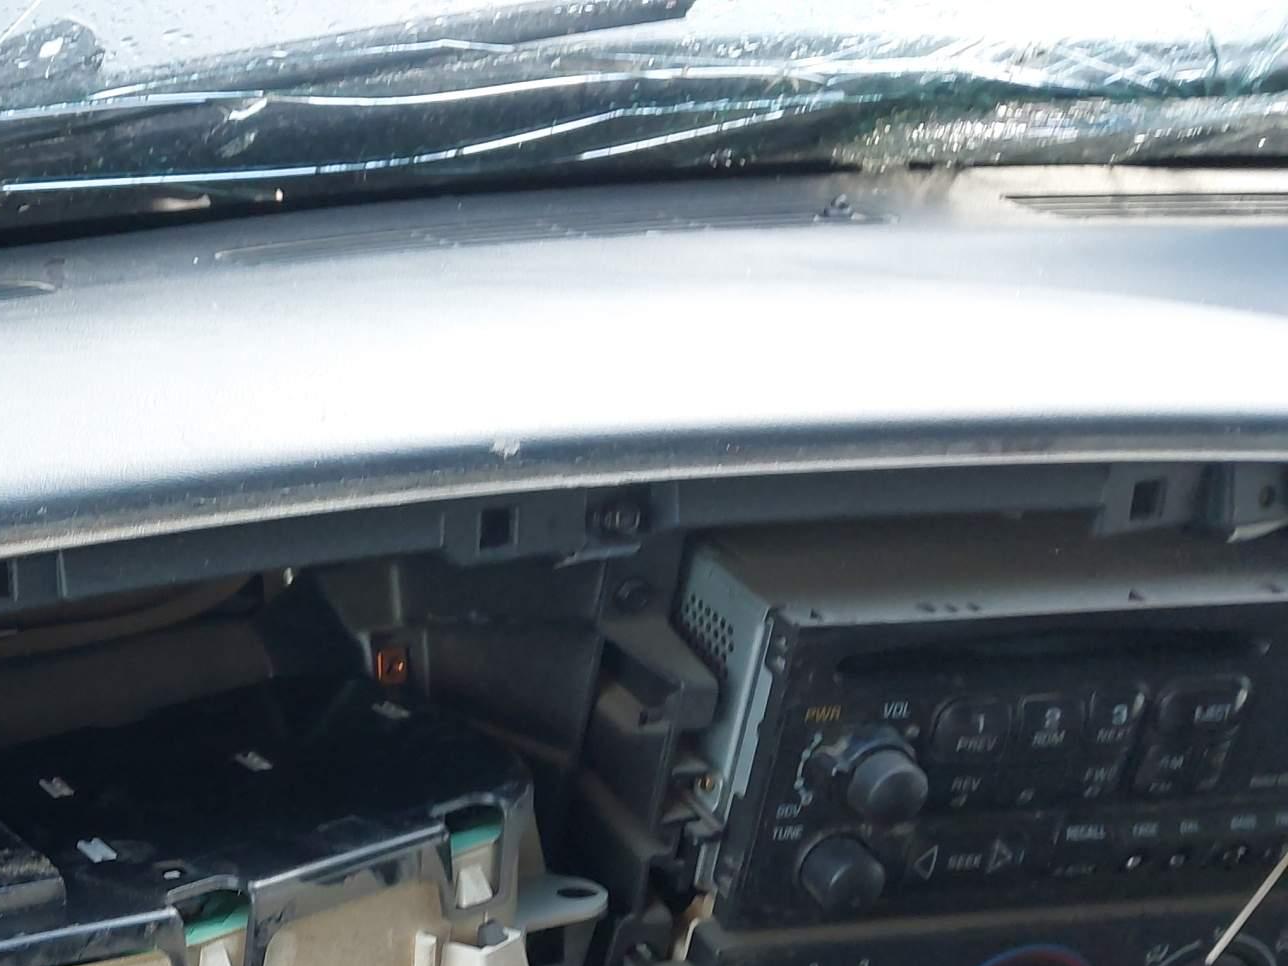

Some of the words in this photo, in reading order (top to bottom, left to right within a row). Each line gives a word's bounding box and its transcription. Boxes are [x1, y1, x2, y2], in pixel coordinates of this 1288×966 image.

[805, 705, 841, 723] PWR
[883, 700, 911, 719] VOL
[1112, 704, 1128, 725] 3
[978, 712, 985, 734] 1
[956, 734, 999, 752] PREV
[772, 824, 804, 841] TUNE
[1065, 824, 1106, 842] RECALL
